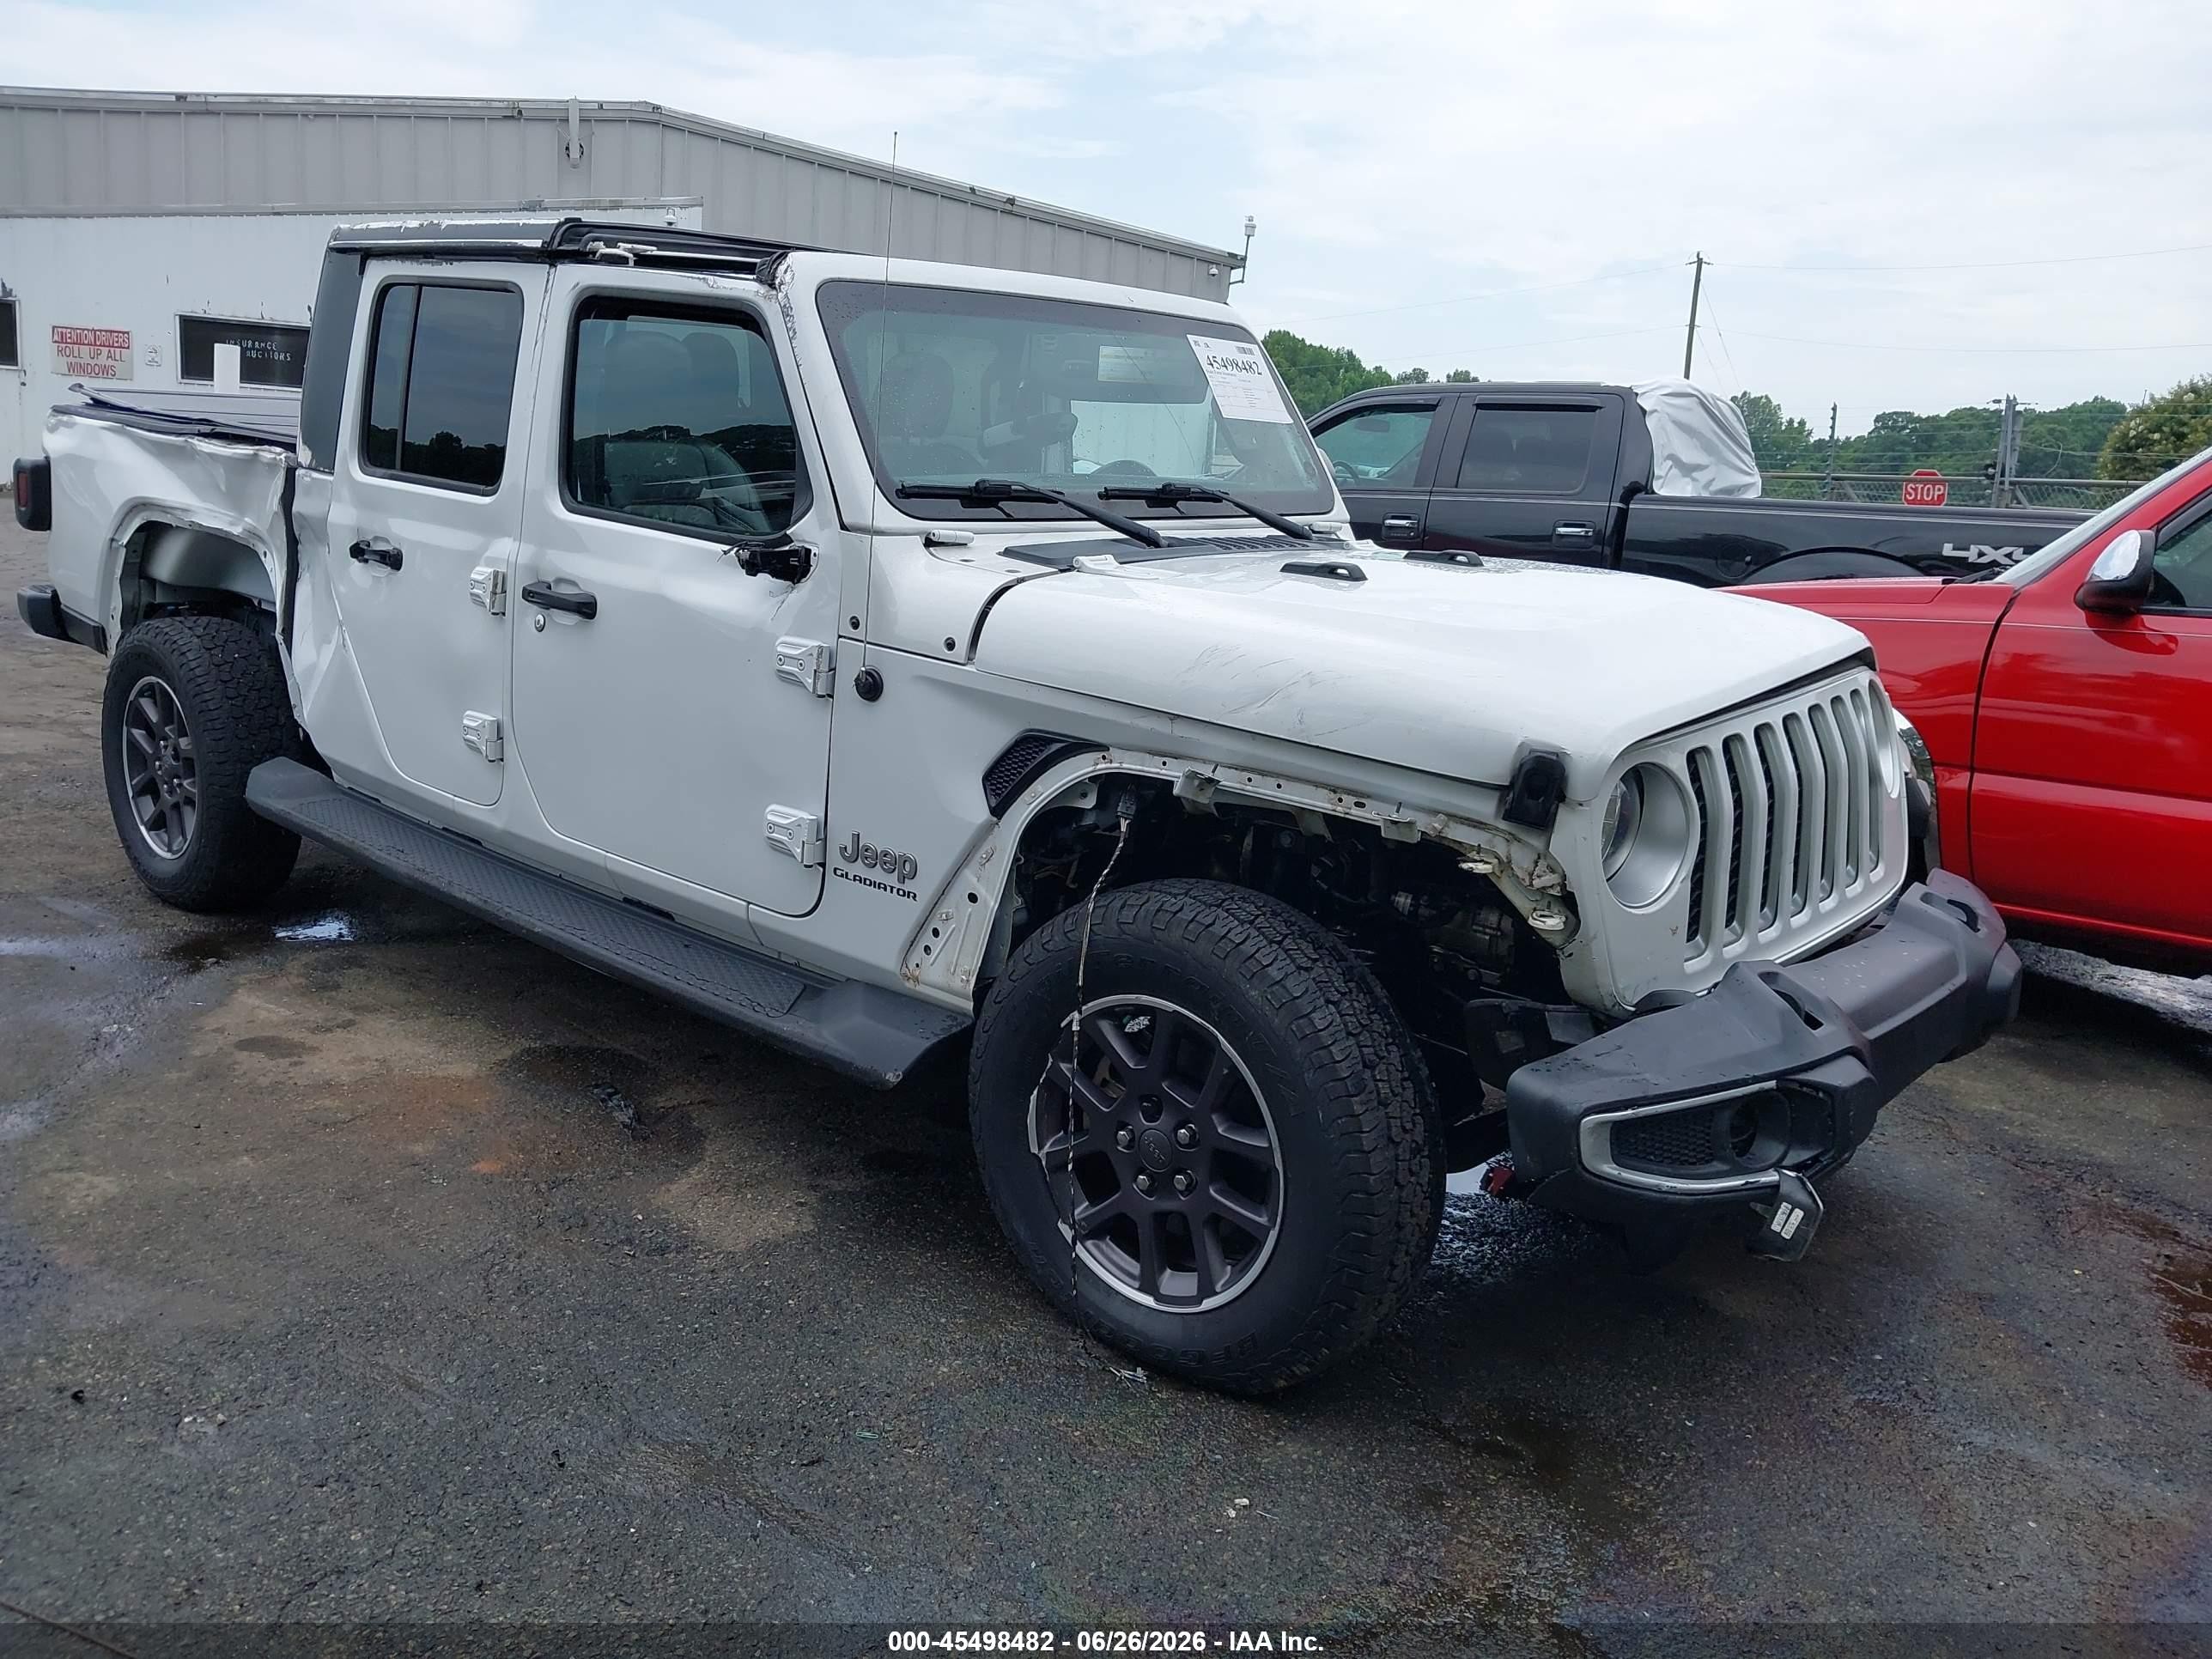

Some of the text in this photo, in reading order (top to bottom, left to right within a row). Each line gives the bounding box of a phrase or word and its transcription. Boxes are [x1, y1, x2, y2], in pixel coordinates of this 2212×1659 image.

[52, 327, 129, 347] ATTENTION DRIVERS
[57, 345, 125, 362] ROLL UP ALL
[66, 361, 117, 377] WINDOWS
[1206, 355, 1262, 375] 45498482
[1905, 483, 1944, 501] STOP
[838, 830, 918, 884] Jeep
[833, 866, 918, 902] GLADIATOR
